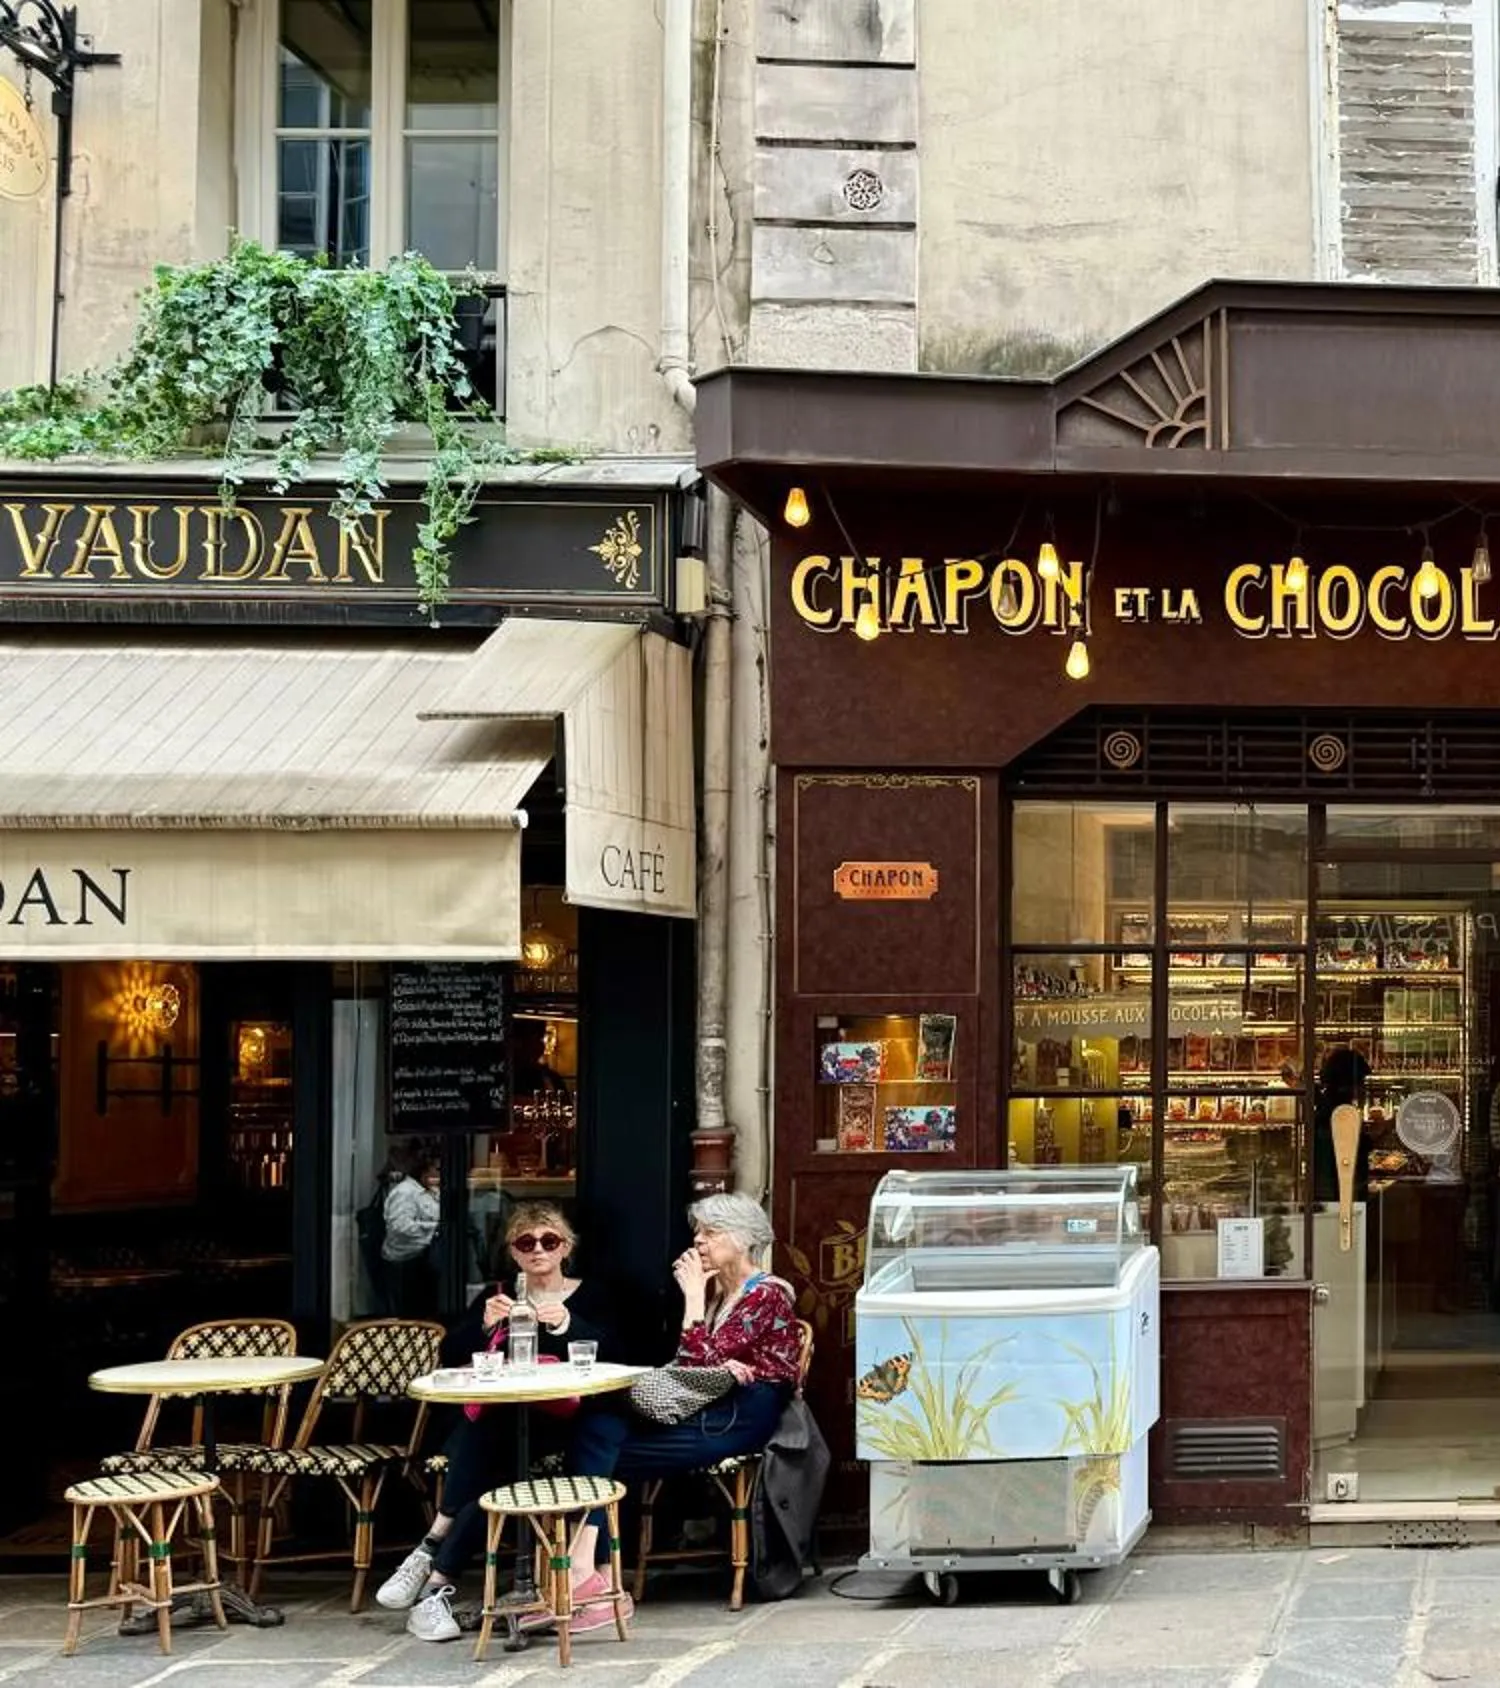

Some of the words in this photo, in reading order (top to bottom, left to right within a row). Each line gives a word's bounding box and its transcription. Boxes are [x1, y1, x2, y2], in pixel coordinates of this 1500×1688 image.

[4, 503, 392, 583] VAUDAN
[791, 555, 1092, 636] CHAPON
[1114, 587, 1154, 623] ET
[1161, 588, 1202, 624] LA
[601, 843, 665, 893] CAFÉ
[849, 868, 924, 887] CHAPON
[0, 867, 131, 925] AN
[1048, 1008, 1109, 1026] MOUSSE
[1115, 1007, 1145, 1023] AUX
